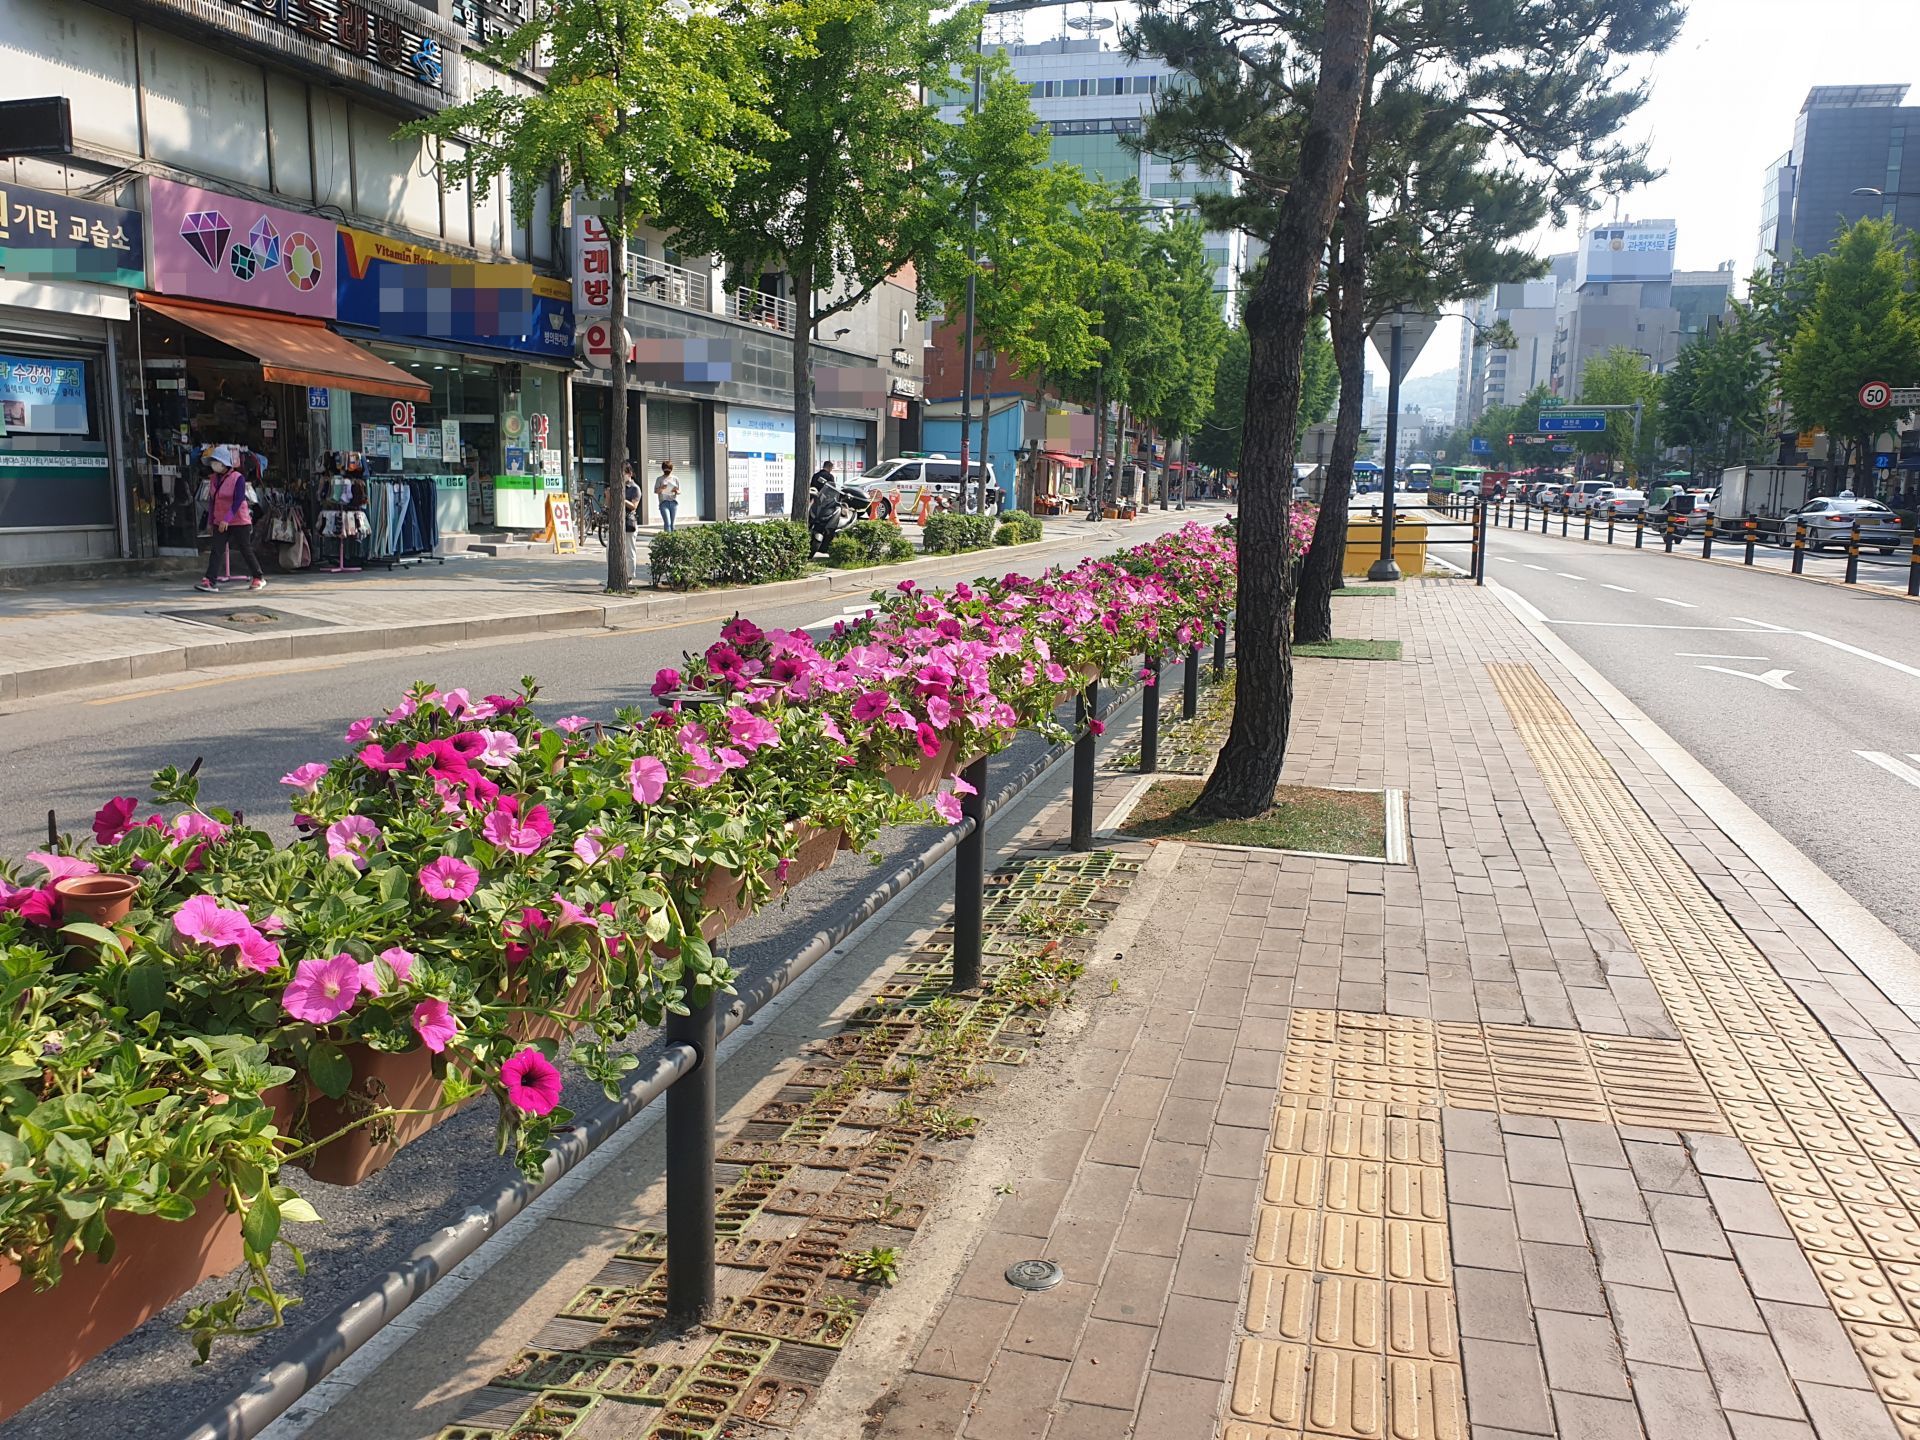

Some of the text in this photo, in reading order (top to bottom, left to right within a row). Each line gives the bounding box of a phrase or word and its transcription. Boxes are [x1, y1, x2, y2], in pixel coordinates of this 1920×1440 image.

[13, 204, 59, 239] 기타
[69, 216, 131, 251] 교습소
[375, 243, 411, 263] Vitamin
[1627, 240, 1665, 252] 관절전문
[583, 219, 611, 306] 노래방
[13, 364, 52, 385] 수강생
[55, 368, 80, 387] 모집
[311, 396, 326, 406] 376
[1867, 389, 1884, 403] 50
[391, 401, 415, 445] 약
[554, 503, 571, 532] 약
